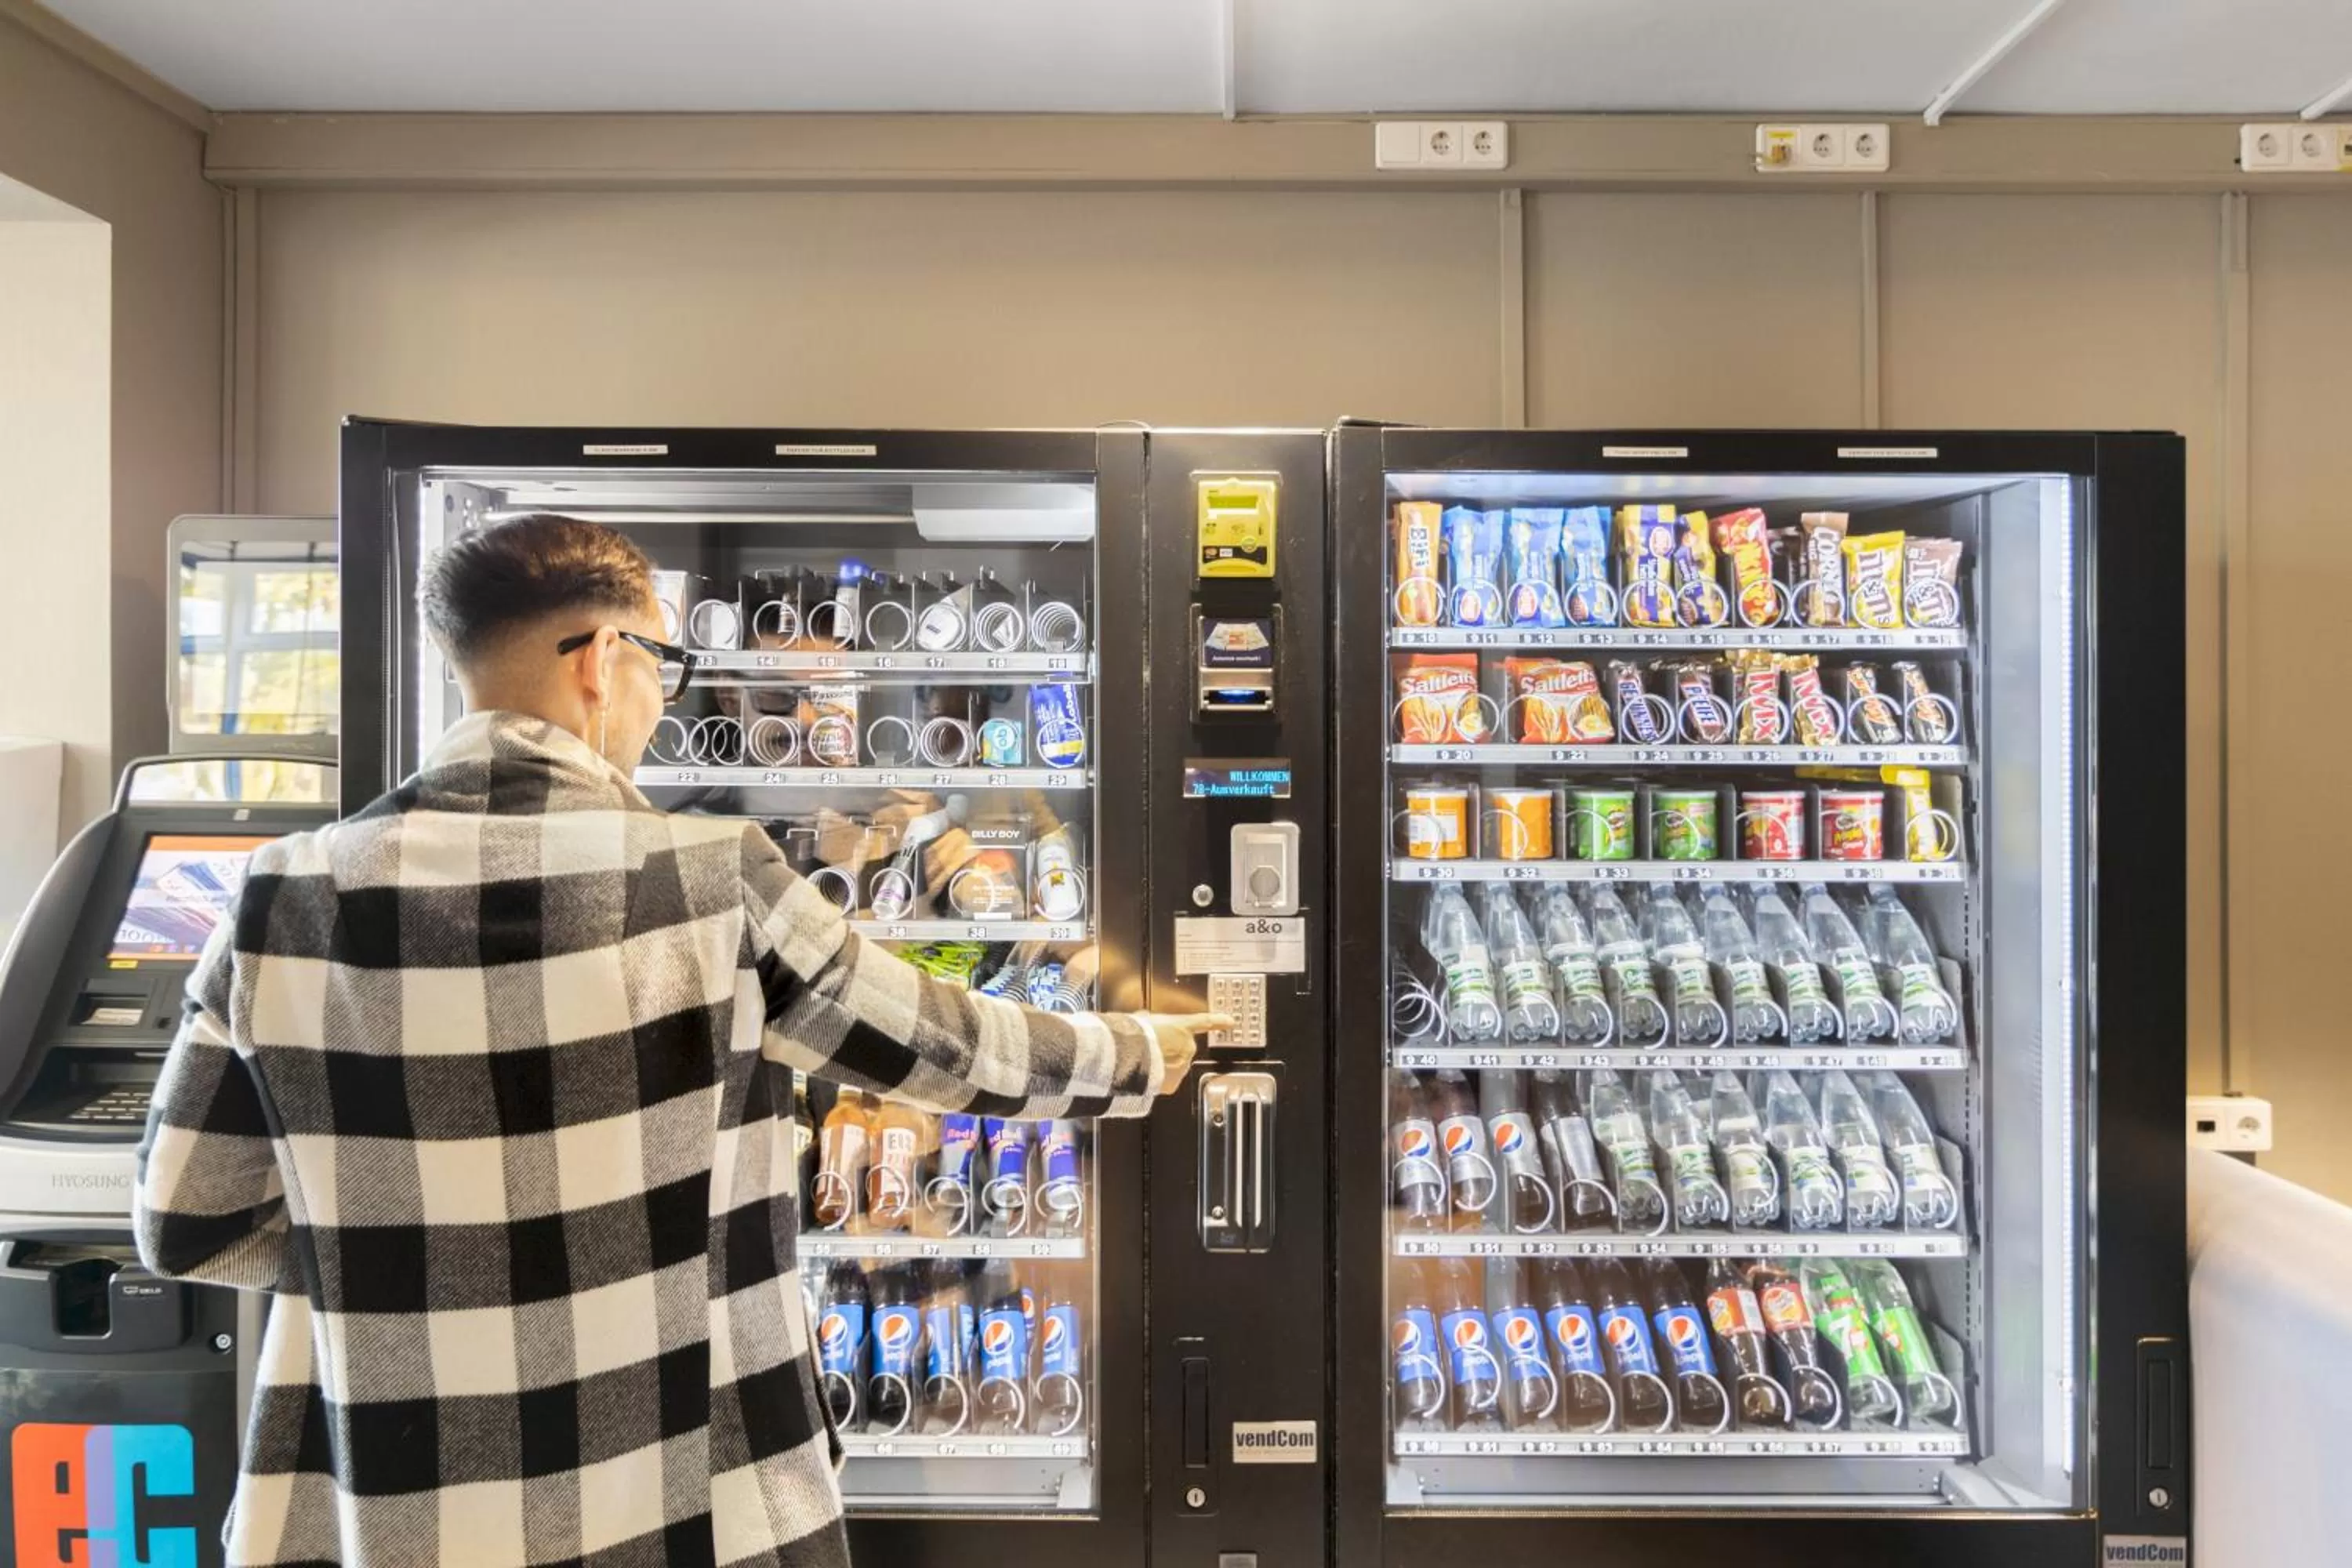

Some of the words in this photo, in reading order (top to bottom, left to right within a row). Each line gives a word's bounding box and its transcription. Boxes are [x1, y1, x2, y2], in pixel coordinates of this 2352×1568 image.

[936, 775, 950, 785] 27
[1229, 771, 1290, 782] WILLKOMMEN
[1245, 919, 1275, 934] a&o
[52, 1173, 131, 1189] HYOSUNG
[1236, 1429, 1314, 1447] vendCom
[2107, 1544, 2183, 1562] vendCom
